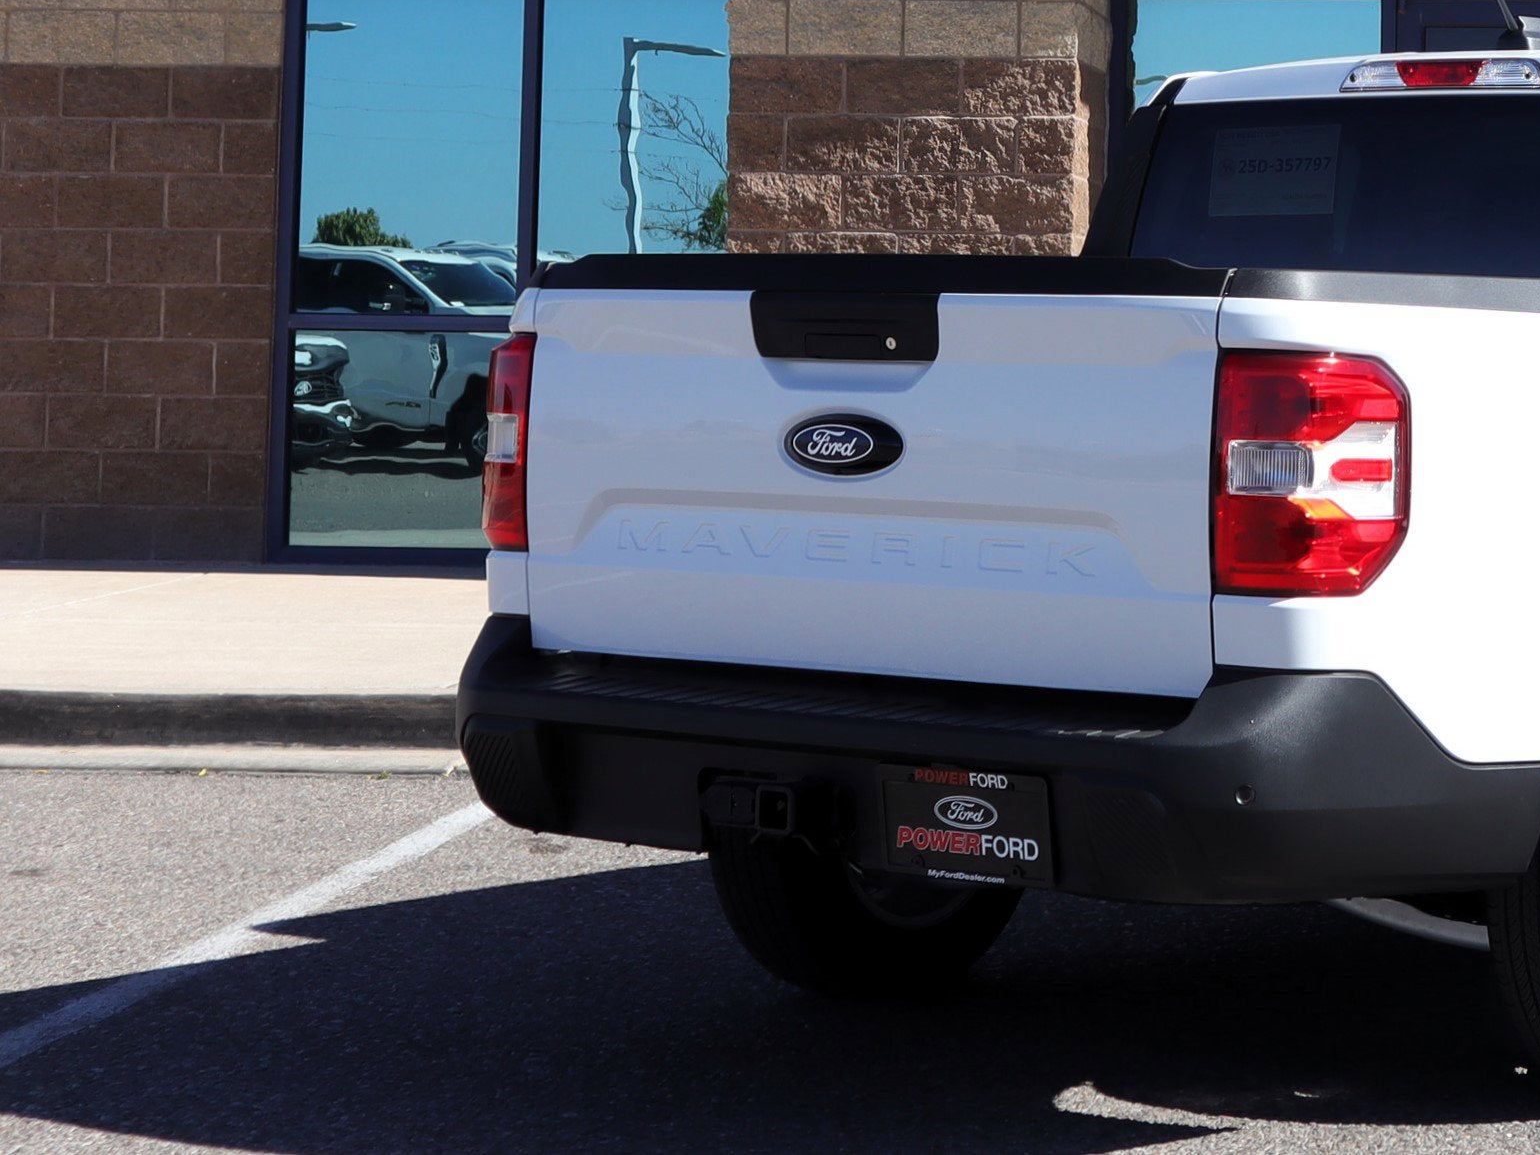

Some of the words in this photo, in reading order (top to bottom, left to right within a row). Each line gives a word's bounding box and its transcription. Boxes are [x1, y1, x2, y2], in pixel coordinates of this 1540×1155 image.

[1238, 156, 1333, 174] 25D-357797
[807, 429, 858, 457] Ford
[615, 517, 1097, 578] MAVERICK
[947, 801, 985, 823] Ford
[927, 869, 1006, 885] MyFordDealer.com
